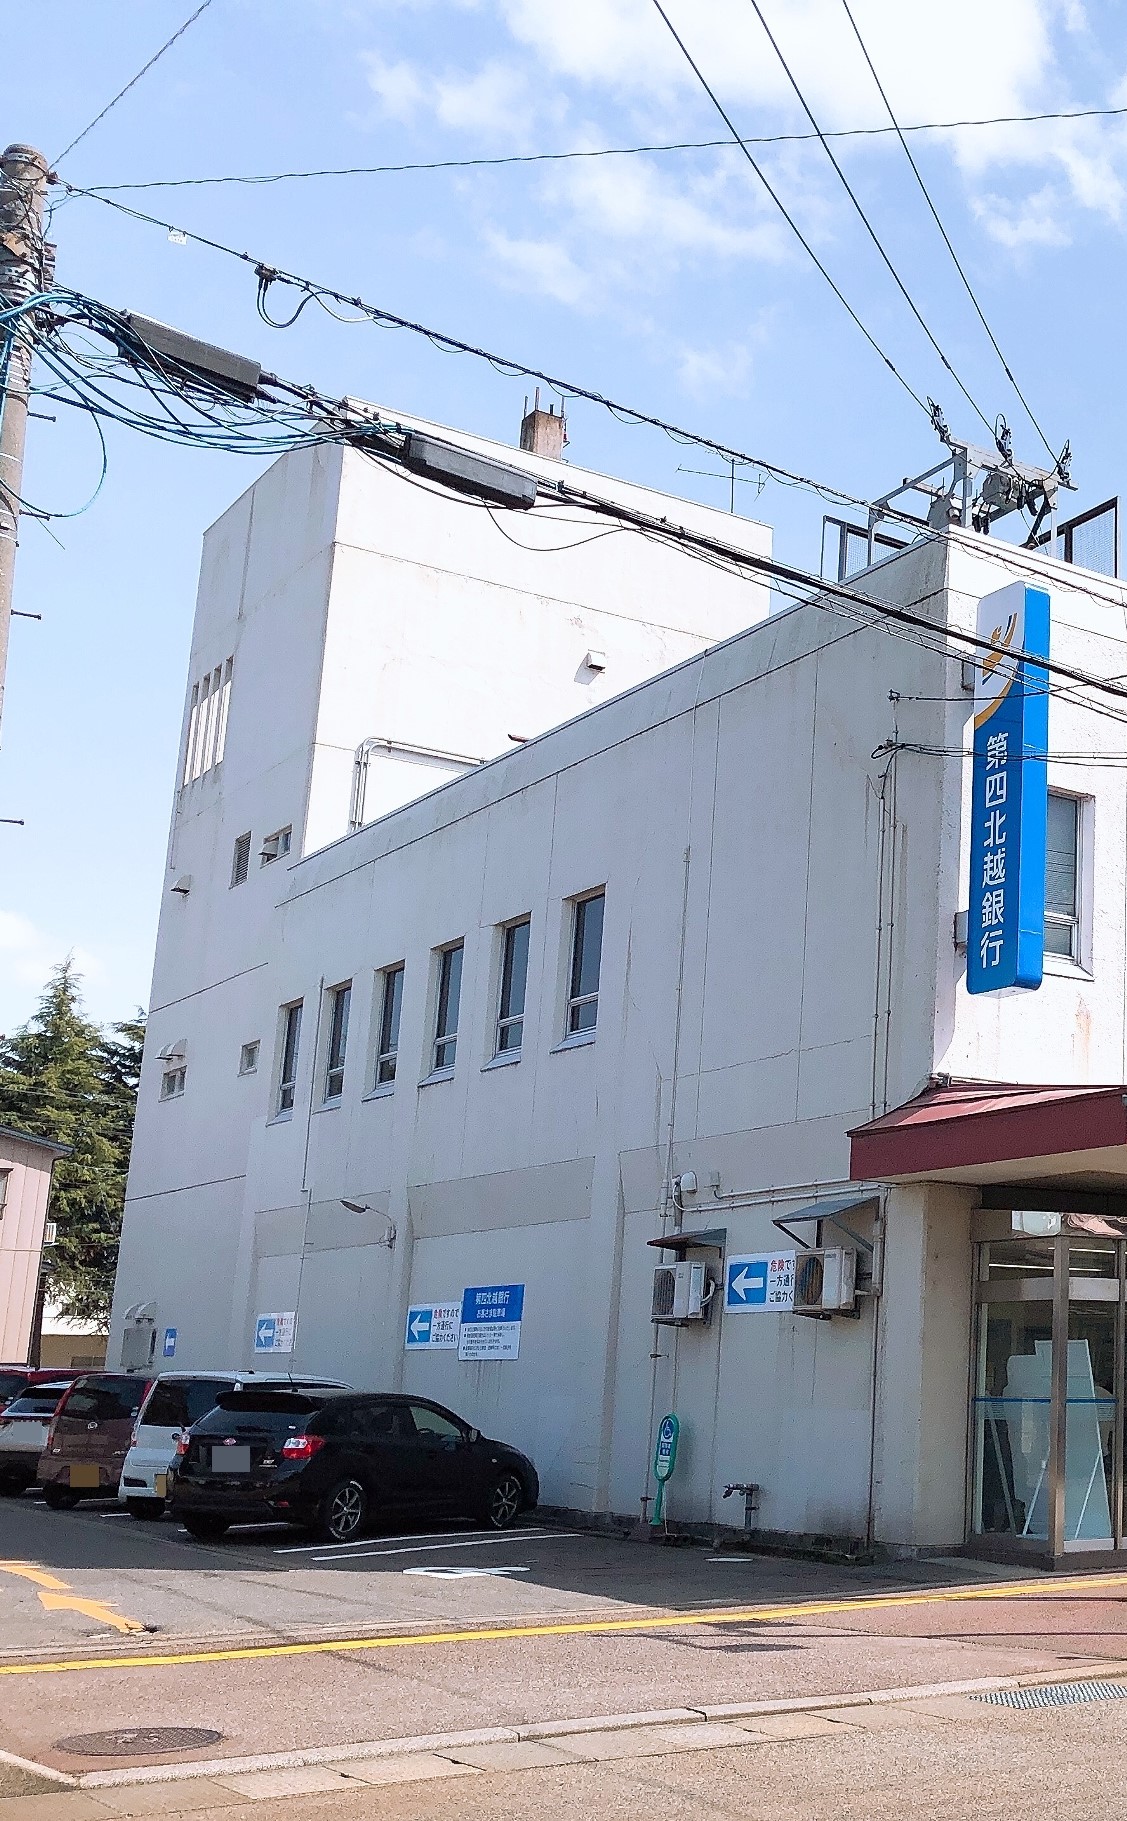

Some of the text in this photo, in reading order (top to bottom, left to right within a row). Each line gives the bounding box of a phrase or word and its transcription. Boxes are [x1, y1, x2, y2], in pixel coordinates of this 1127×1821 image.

[980, 731, 1010, 969] 第四北越銀行
